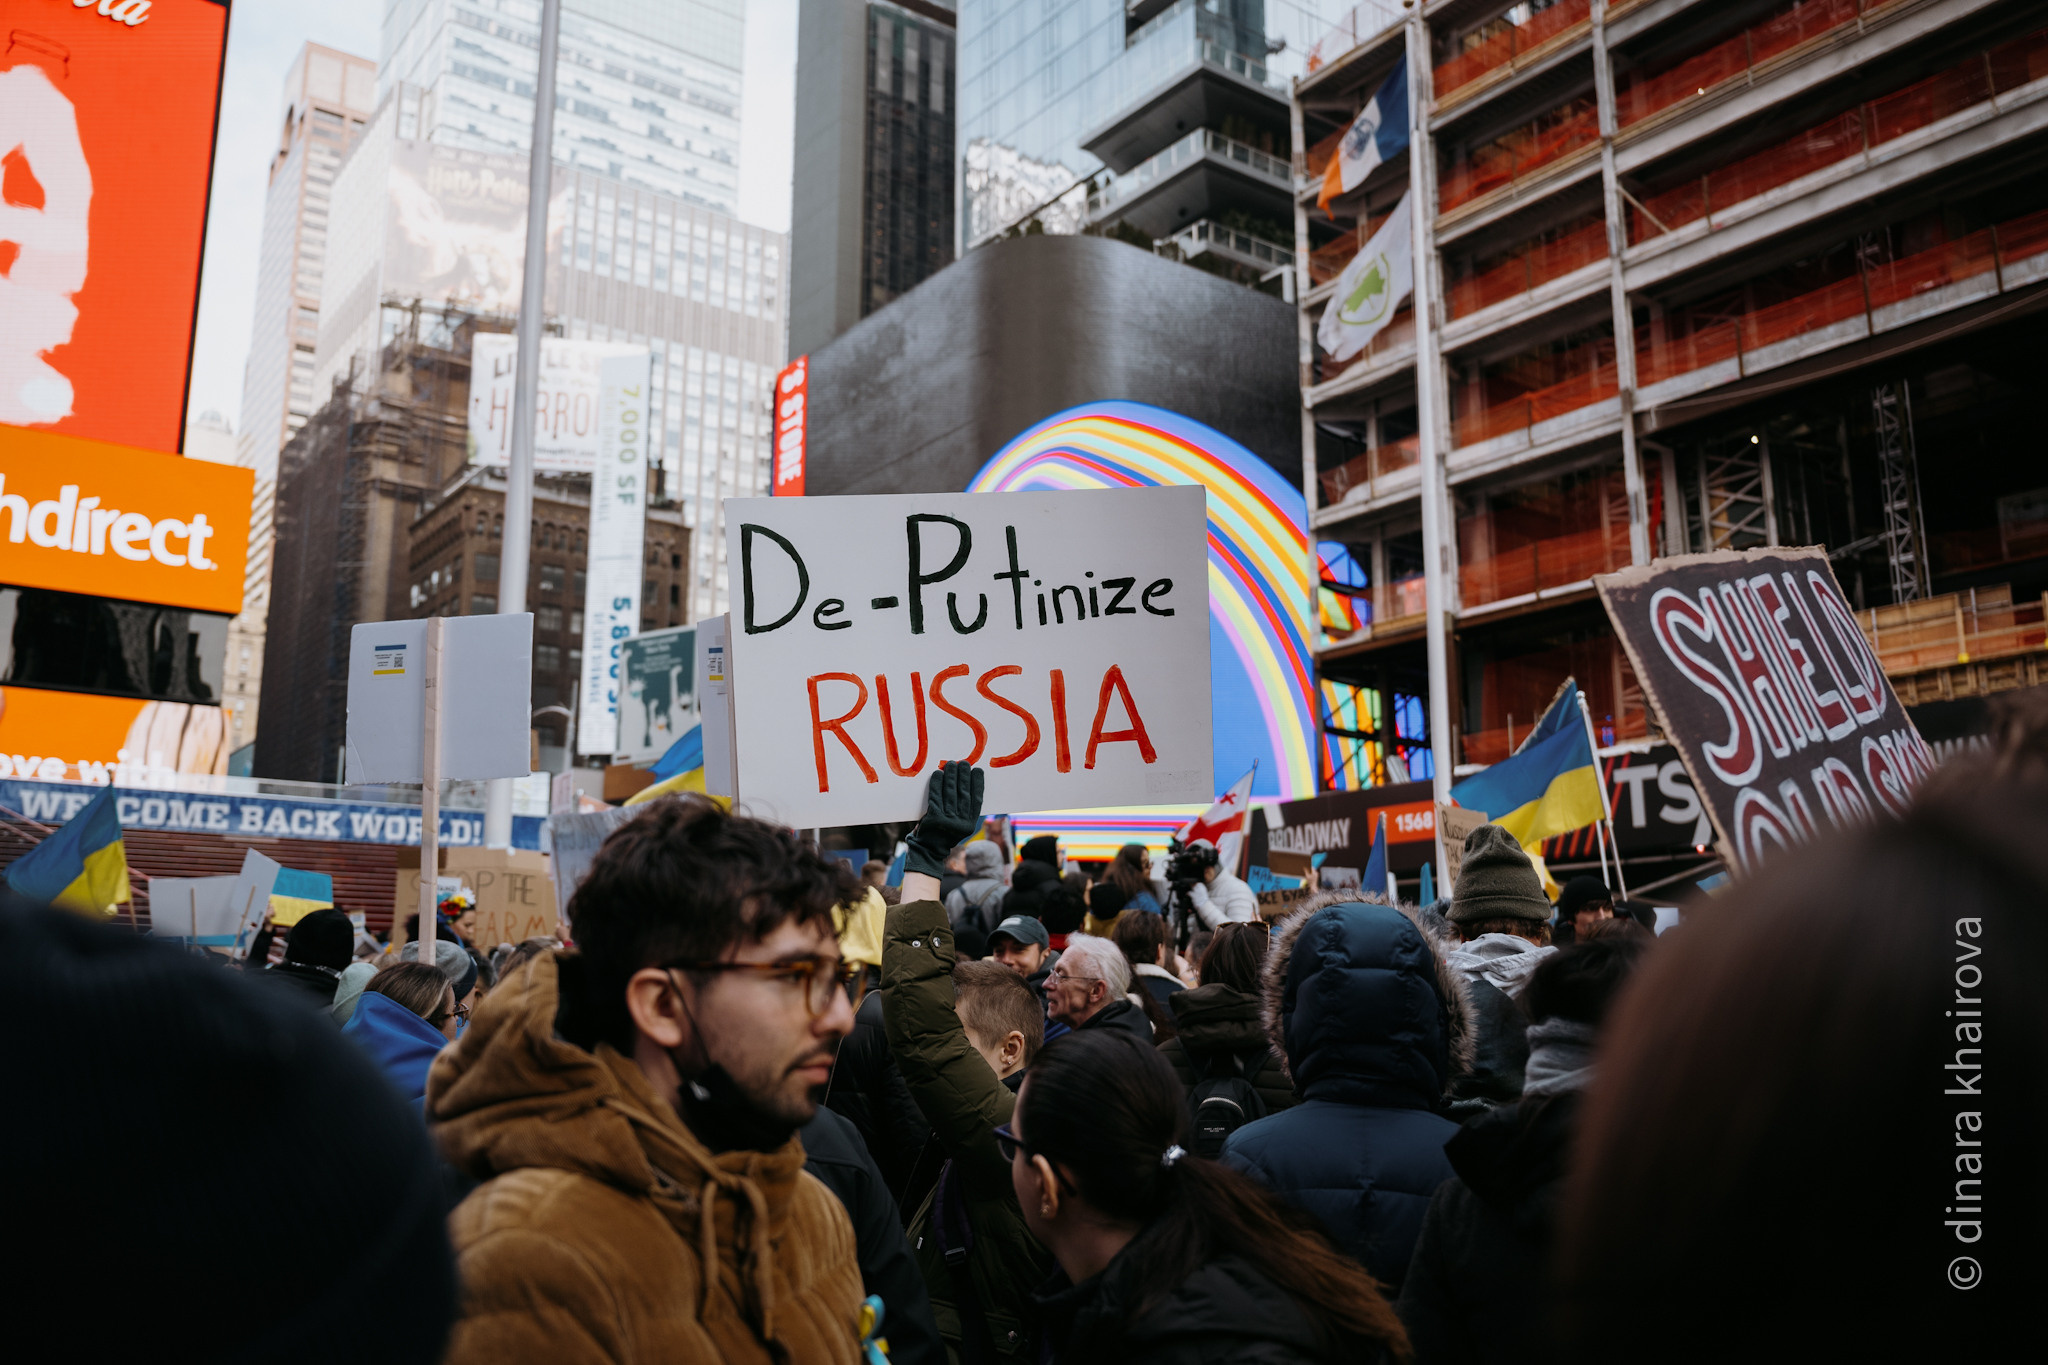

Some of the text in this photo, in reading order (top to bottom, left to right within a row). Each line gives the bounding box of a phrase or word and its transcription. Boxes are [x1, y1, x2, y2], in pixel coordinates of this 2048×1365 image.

[494, 348, 570, 379] LILE
[489, 387, 601, 451] HRRO
[616, 384, 641, 505] 7,000 SF
[778, 393, 805, 486] STORE
[740, 513, 1175, 635] De-Putinize
[1650, 569, 1887, 787] SHIELD
[806, 663, 1158, 793] RUSSIA
[19, 789, 231, 831] WECOME
[239, 804, 342, 841] BACK
[1268, 817, 1350, 851] BROADWAY
[1395, 810, 1434, 833] 1568
[410, 869, 537, 907] SOP THE
